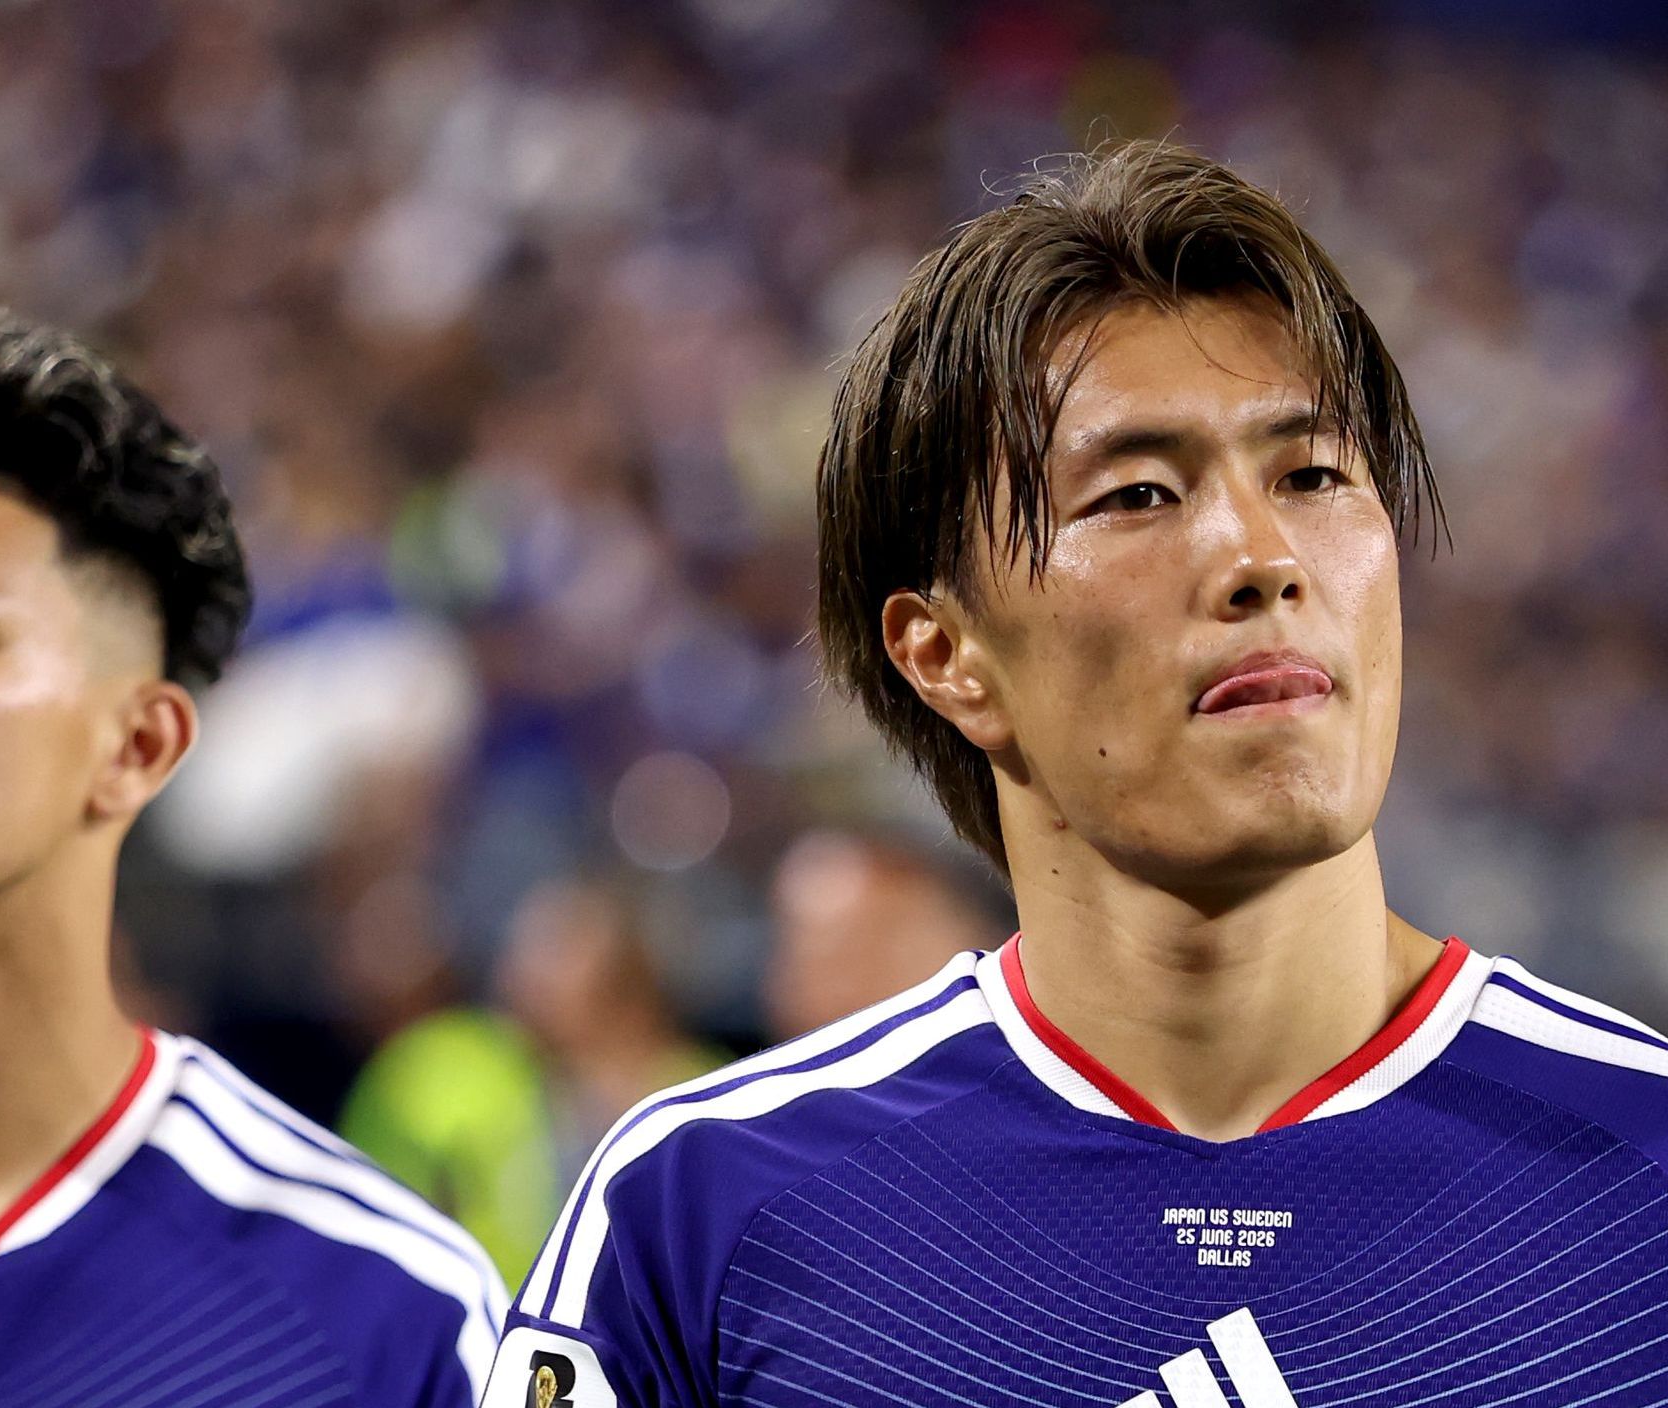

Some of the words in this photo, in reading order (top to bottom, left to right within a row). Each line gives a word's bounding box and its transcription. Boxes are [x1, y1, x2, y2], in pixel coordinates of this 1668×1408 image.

[1161, 1207, 1206, 1225] JAPAN
[1232, 1209, 1293, 1229] SWEDEN
[1175, 1227, 1196, 1245] 25
[1199, 1228, 1234, 1246] JUNE
[1237, 1229, 1276, 1248] 2026
[1197, 1248, 1252, 1268] DALLAS
